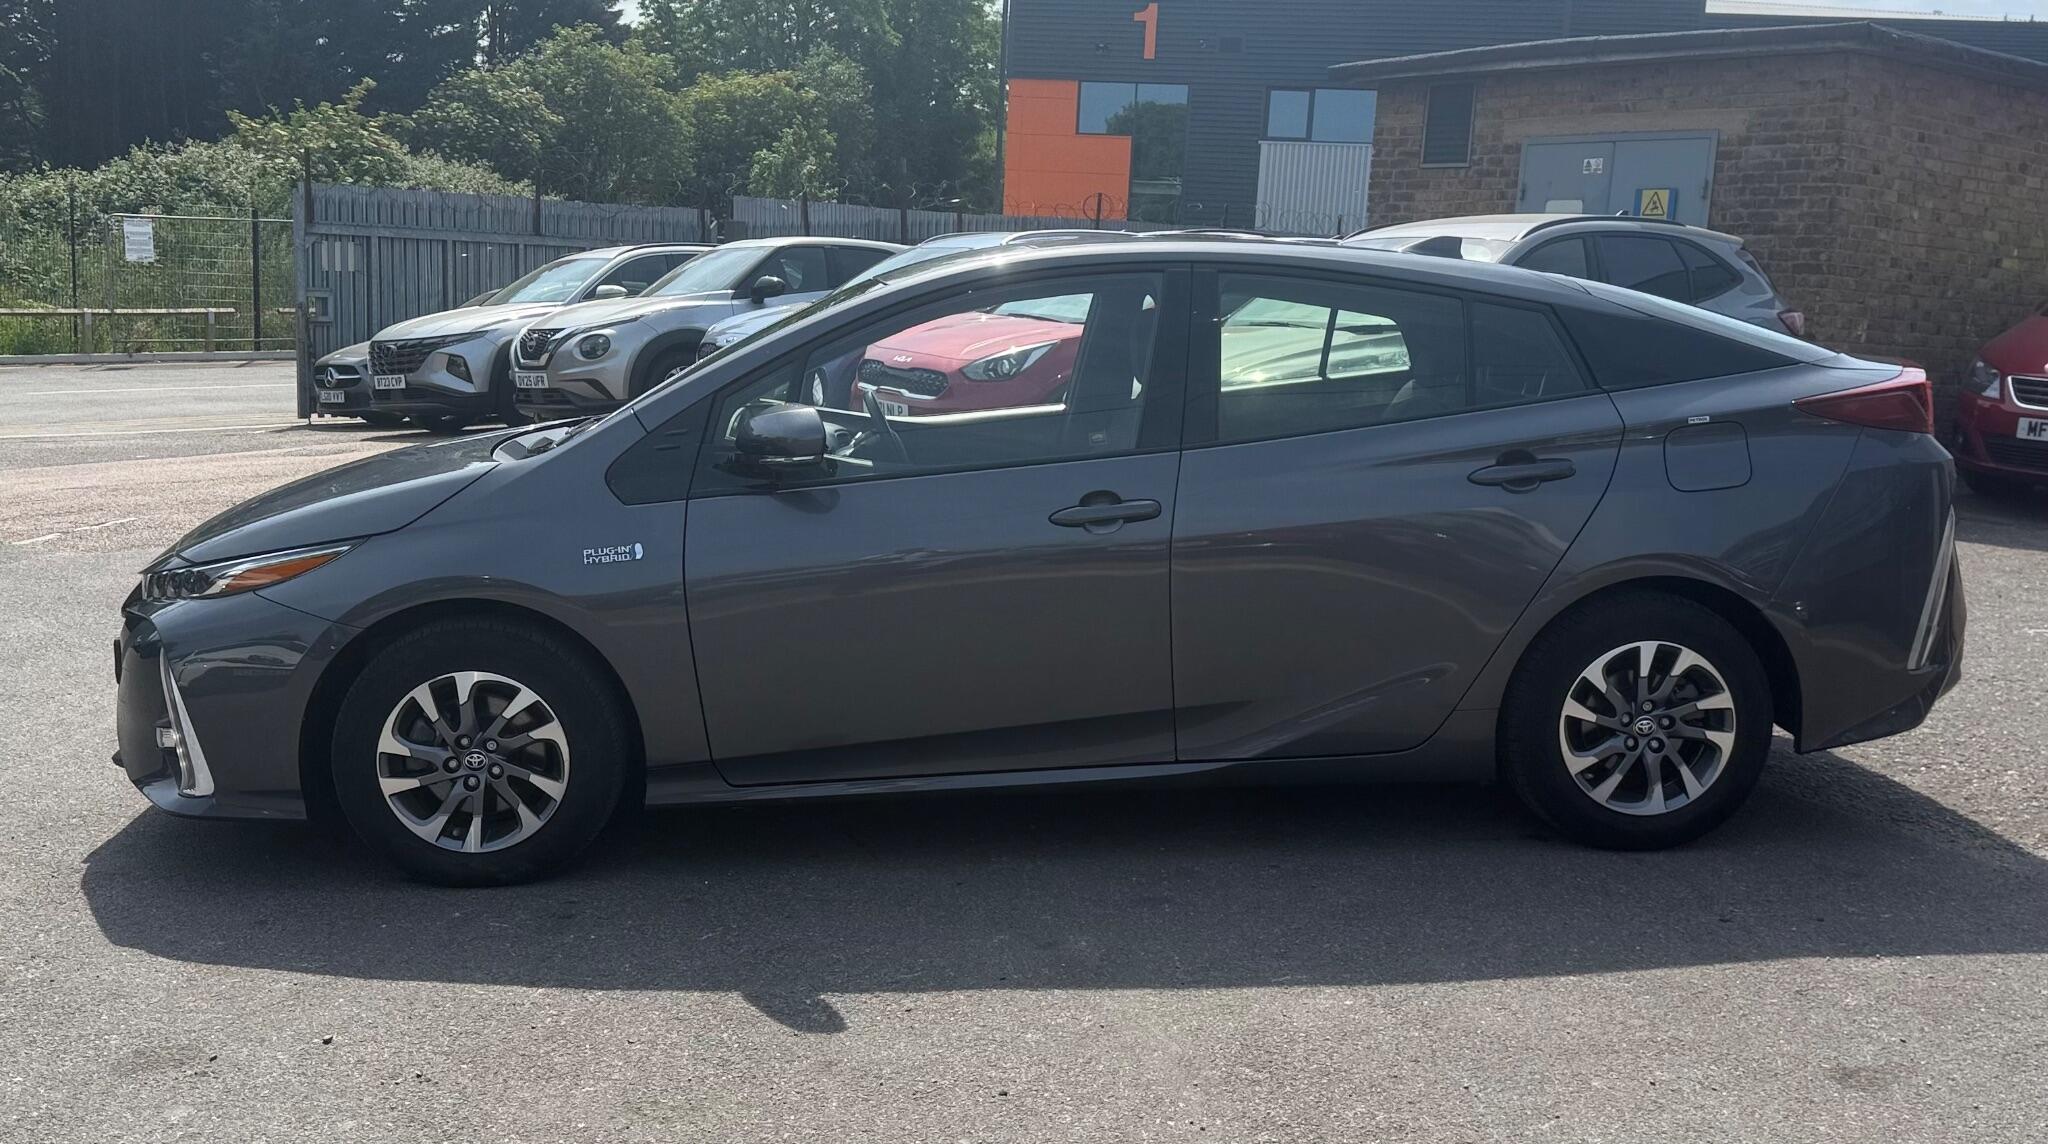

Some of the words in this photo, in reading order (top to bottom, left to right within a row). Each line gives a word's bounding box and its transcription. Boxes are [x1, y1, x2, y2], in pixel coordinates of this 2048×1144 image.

[1133, 3, 1158, 59] 1
[583, 545, 631, 556] PLUG-IN
[584, 554, 630, 564] HYBRID
